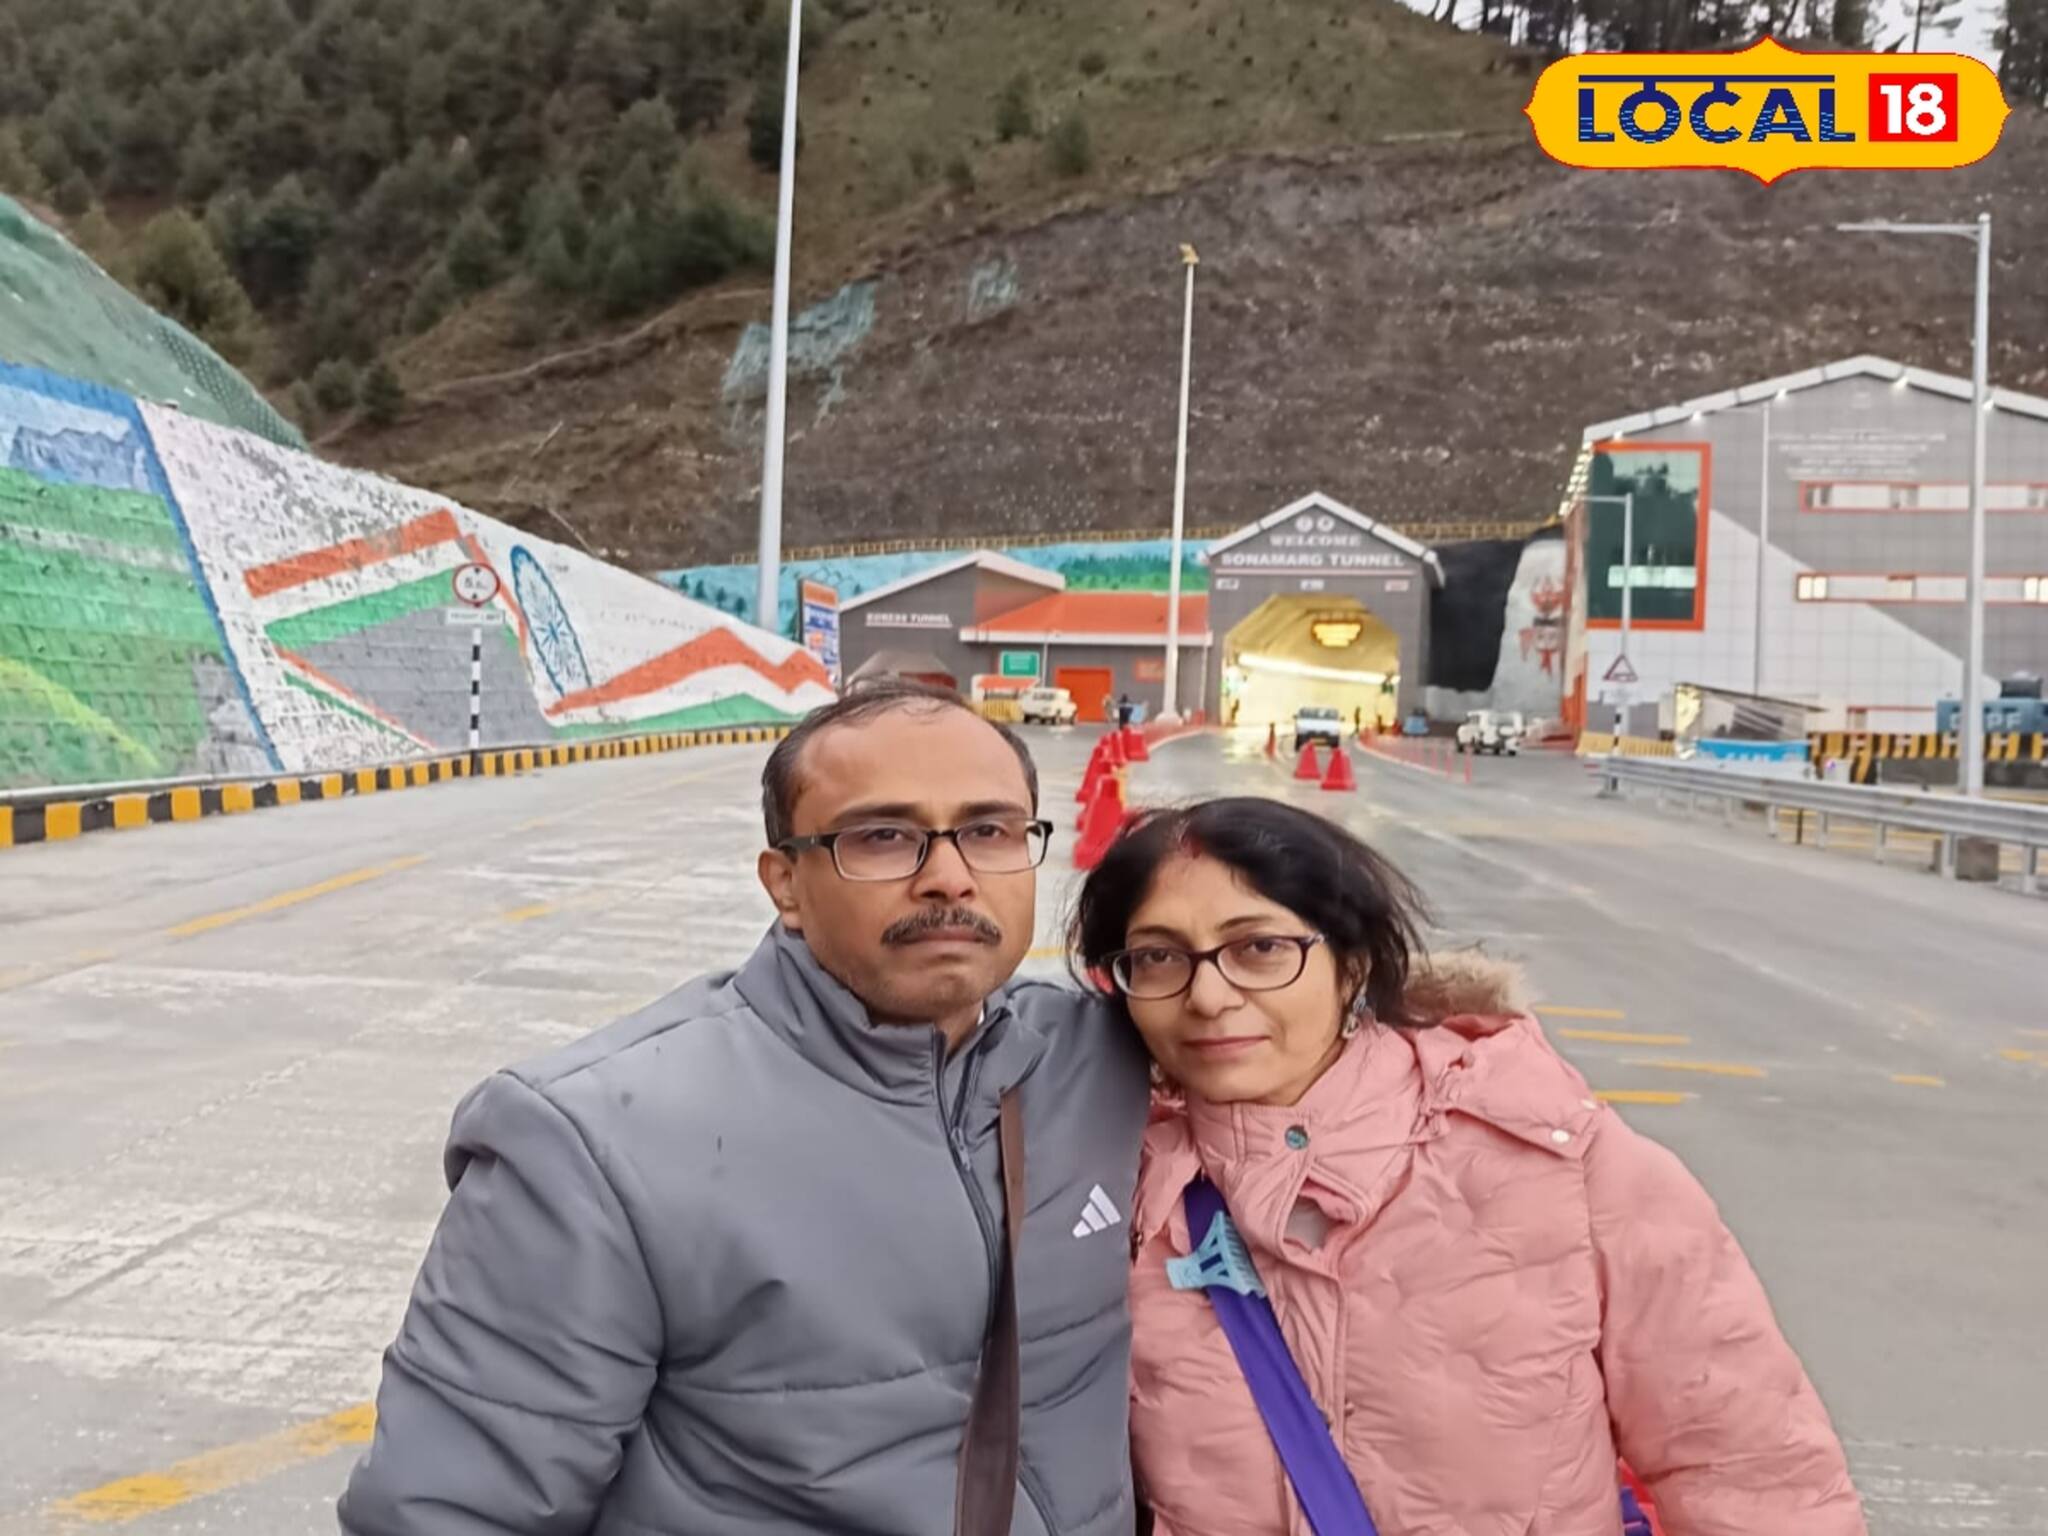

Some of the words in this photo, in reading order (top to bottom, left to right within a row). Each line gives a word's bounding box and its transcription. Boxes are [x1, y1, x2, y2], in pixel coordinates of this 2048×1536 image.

[1269, 534, 1362, 547] WELCOME
[1221, 553, 1323, 567] SONAMARG
[1330, 553, 1404, 568] TUNNEL
